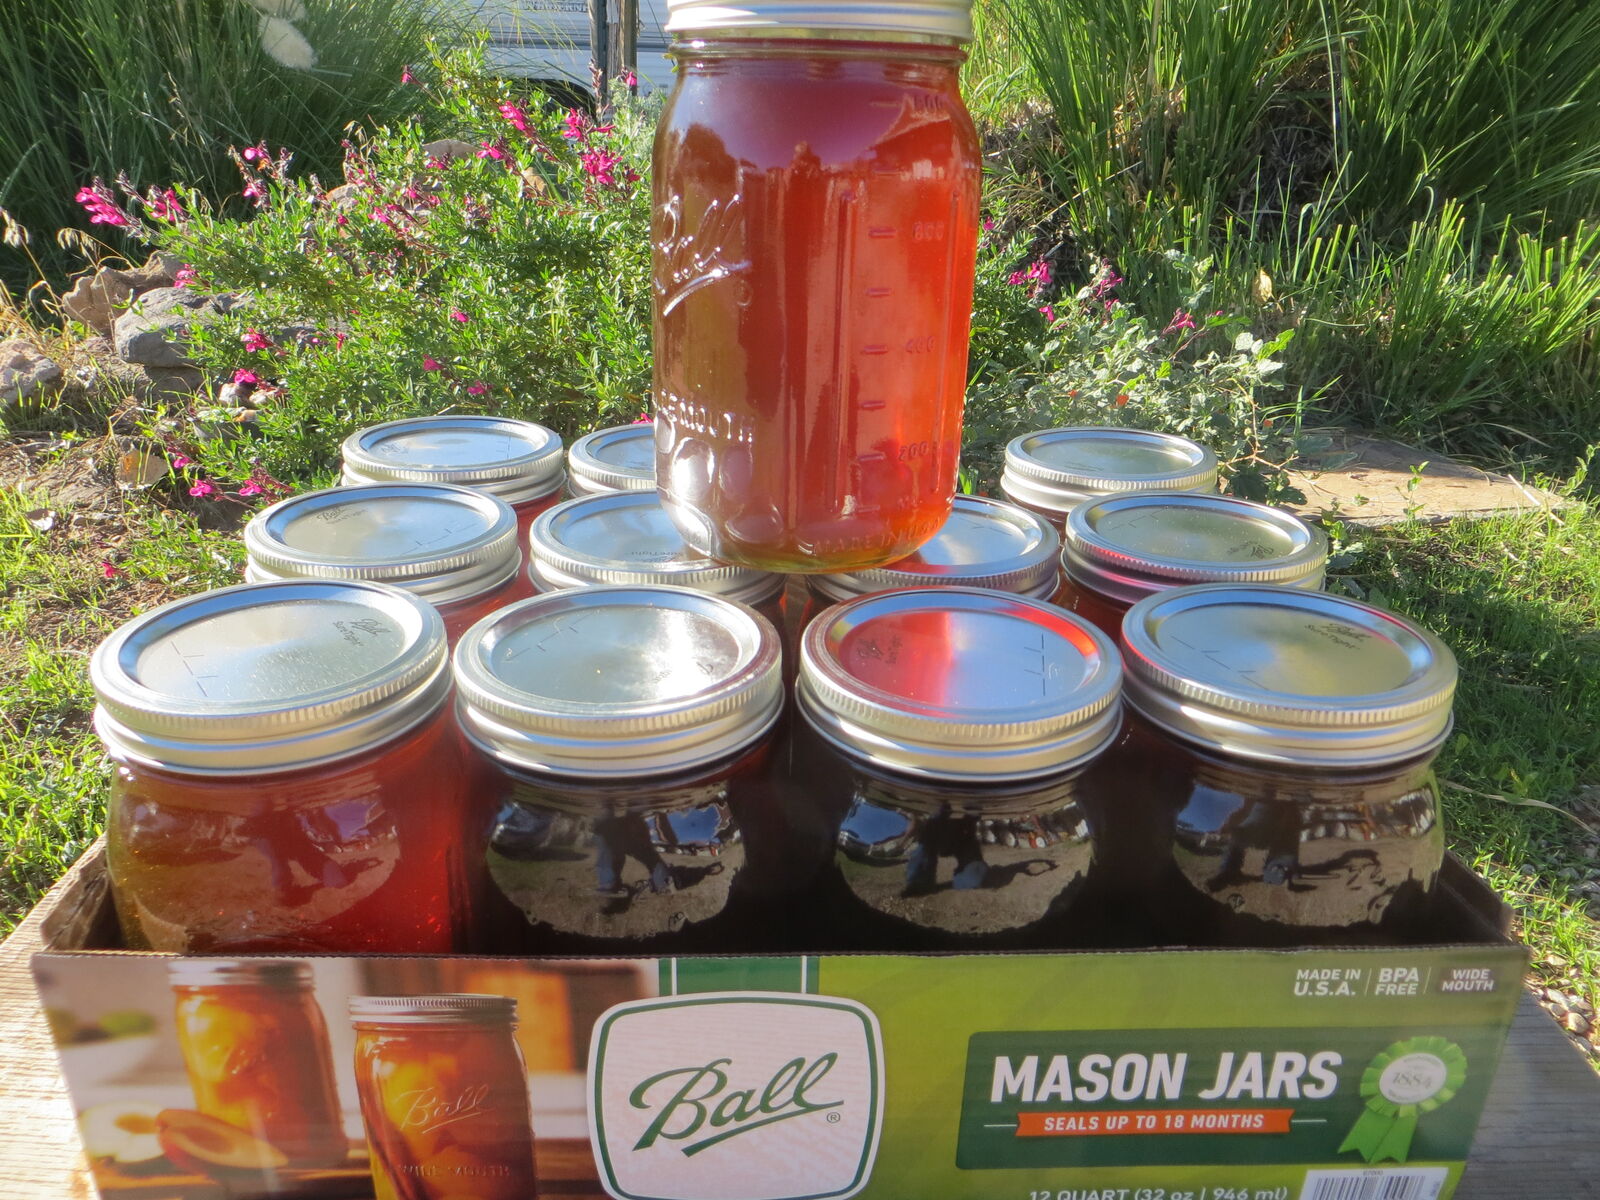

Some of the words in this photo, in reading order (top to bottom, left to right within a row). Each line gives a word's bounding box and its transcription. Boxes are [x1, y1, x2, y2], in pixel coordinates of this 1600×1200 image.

[1296, 968, 1342, 980] MADE
[1344, 968, 1362, 980] IN
[1377, 967, 1420, 983] BPA
[1452, 968, 1491, 980] WIDE
[1294, 981, 1356, 996] U.S.A.
[1375, 983, 1419, 996] FREE
[1441, 980, 1495, 992] MOUTH
[990, 1052, 1188, 1103] MASON
[1198, 1050, 1343, 1100] JARS
[397, 1084, 496, 1134] Ball
[629, 1052, 844, 1157] Ball
[1044, 1116, 1099, 1132] SEALS
[1105, 1115, 1129, 1131] UP
[1135, 1114, 1156, 1130] TO
[1164, 1114, 1183, 1129] 18
[1190, 1113, 1265, 1129] MONTHS
[1029, 1190, 1051, 1200] 12
[1057, 1189, 1130, 1200] QUART
[1134, 1187, 1165, 1200] (32
[1170, 1190, 1194, 1200] oz
[1213, 1187, 1249, 1200] 946
